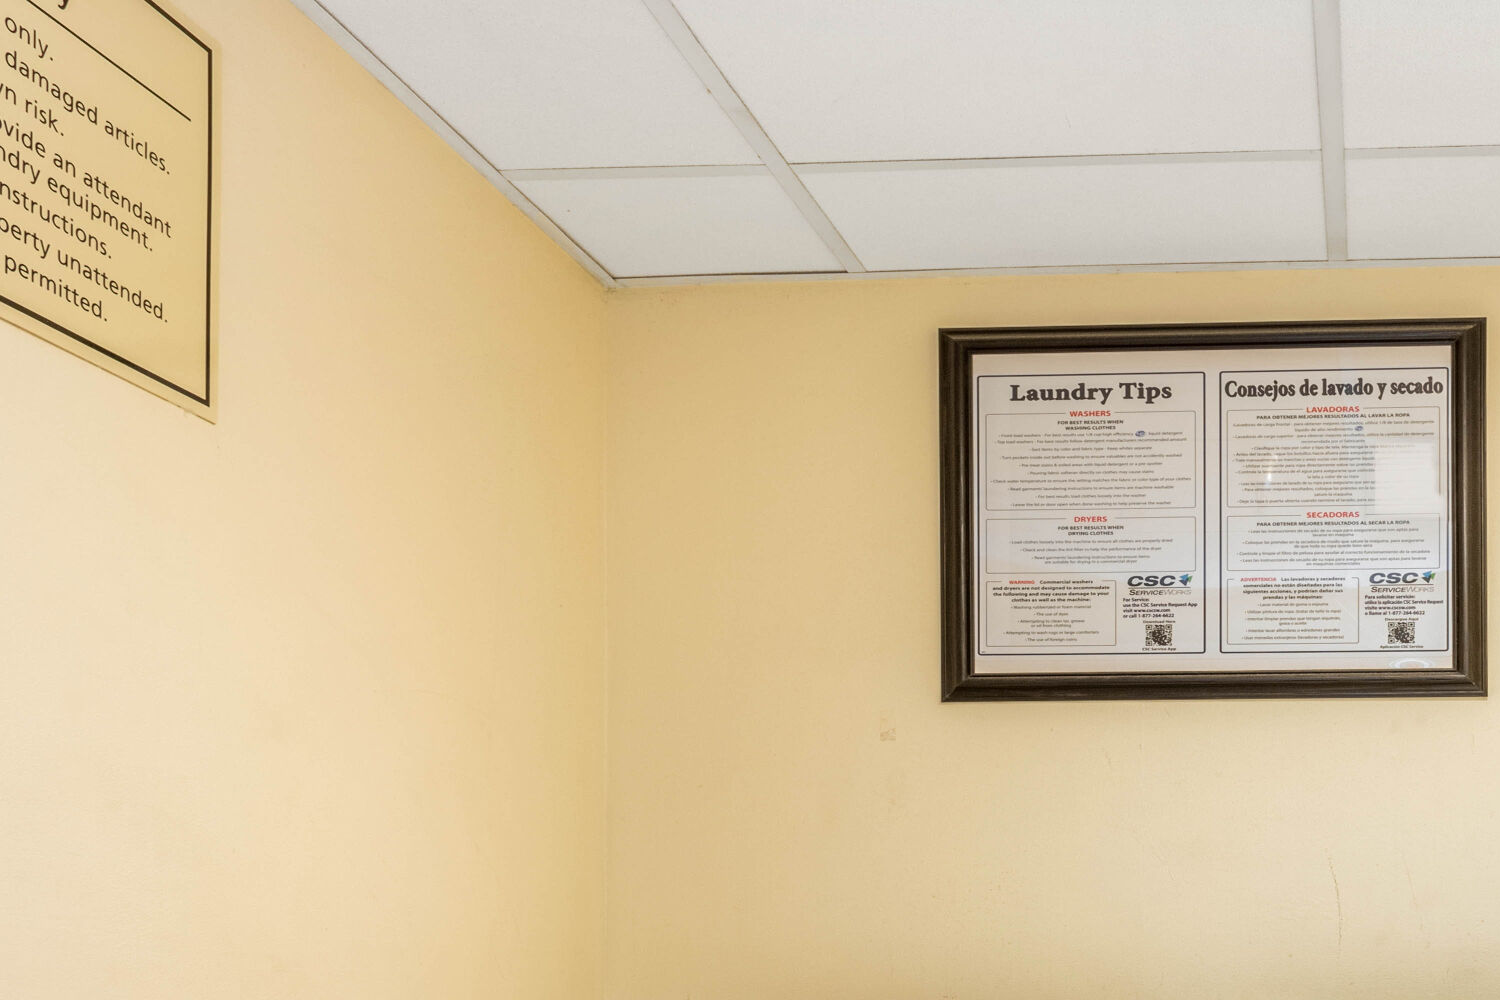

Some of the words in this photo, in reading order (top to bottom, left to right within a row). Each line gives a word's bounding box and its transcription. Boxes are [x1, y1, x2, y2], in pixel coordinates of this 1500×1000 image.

[5, 17, 53, 61] only.
[5, 50, 98, 125] damaged
[105, 120, 170, 175] articles.
[25, 100, 64, 136] risk.
[0, 120, 46, 158] vide
[53, 153, 76, 178] an
[83, 169, 171, 238] attendant
[48, 177, 153, 251] equipment.
[5, 253, 107, 322] permitted.
[57, 250, 168, 323] unattended.
[1010, 383, 1113, 405] Laundry
[1119, 382, 1172, 404] Tips
[1225, 380, 1295, 402] Consejos
[1300, 379, 1318, 396] de
[1322, 378, 1373, 395] lavado
[1377, 381, 1387, 400] y
[1390, 377, 1443, 394] secado
[1306, 406, 1360, 414] LAVADORAS
[1128, 575, 1176, 587] CSC
[1369, 572, 1419, 584] CSC
